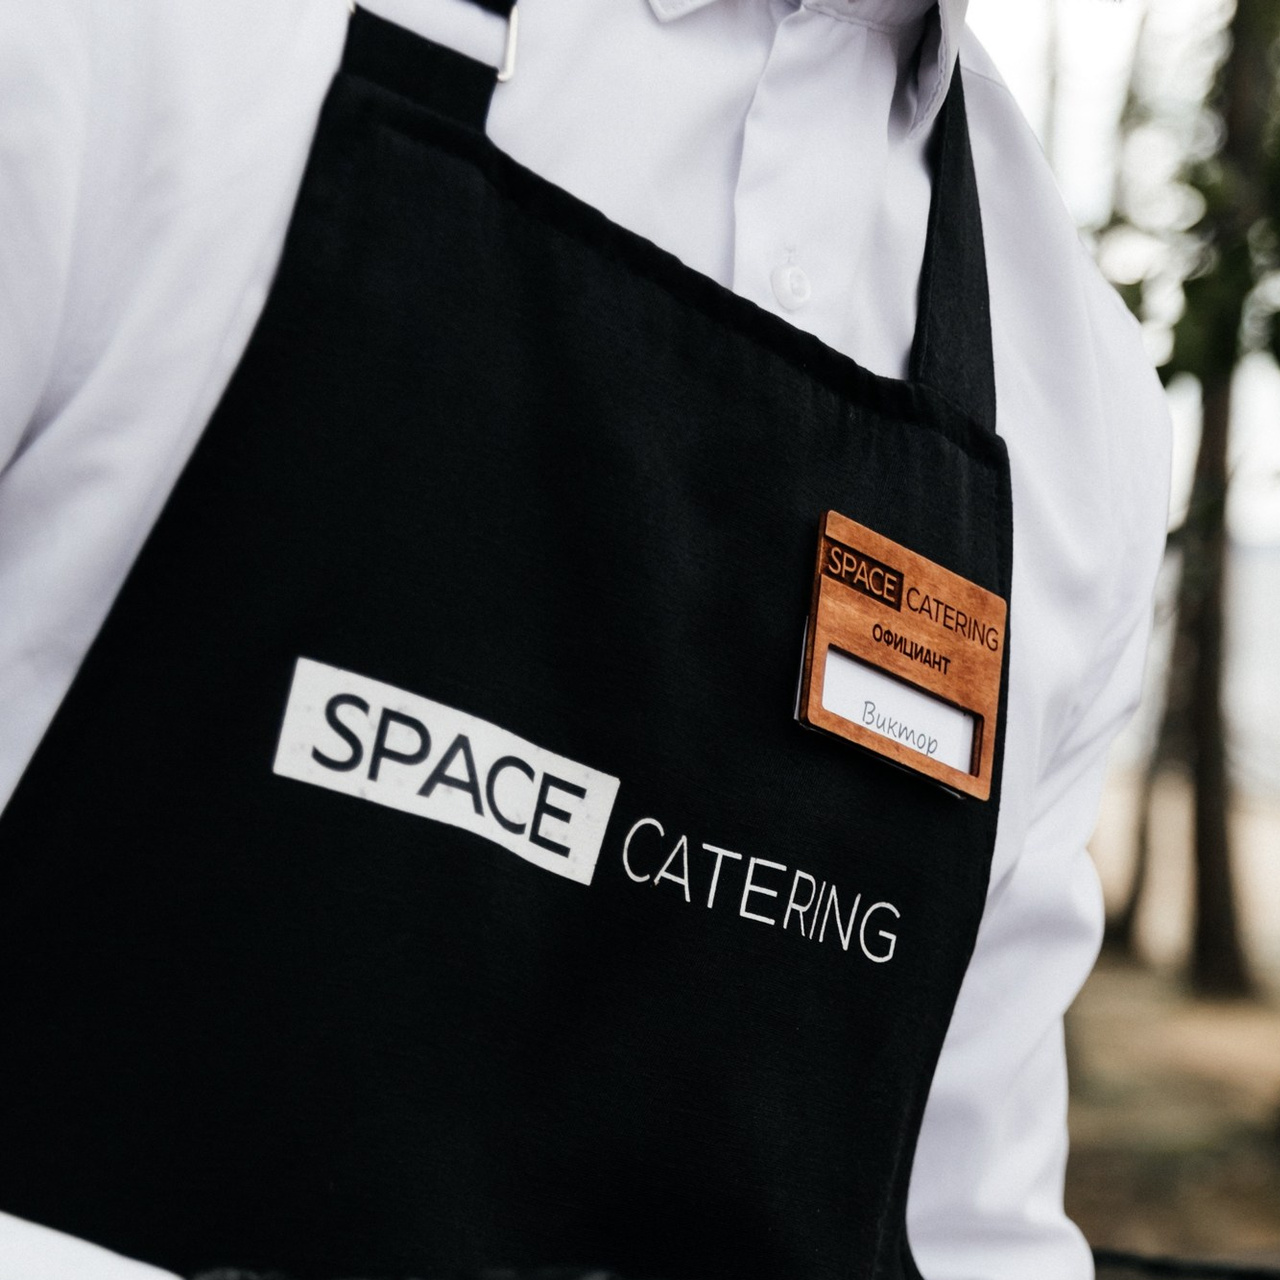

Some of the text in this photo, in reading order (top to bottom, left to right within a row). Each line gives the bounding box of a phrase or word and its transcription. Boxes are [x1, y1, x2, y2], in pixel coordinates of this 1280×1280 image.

[828, 546, 999, 651] SPACE CATERING
[872, 623, 951, 675] ОФИЦИАНТ
[861, 700, 938, 755] Виктор
[312, 692, 901, 963] SPACE CATERING
